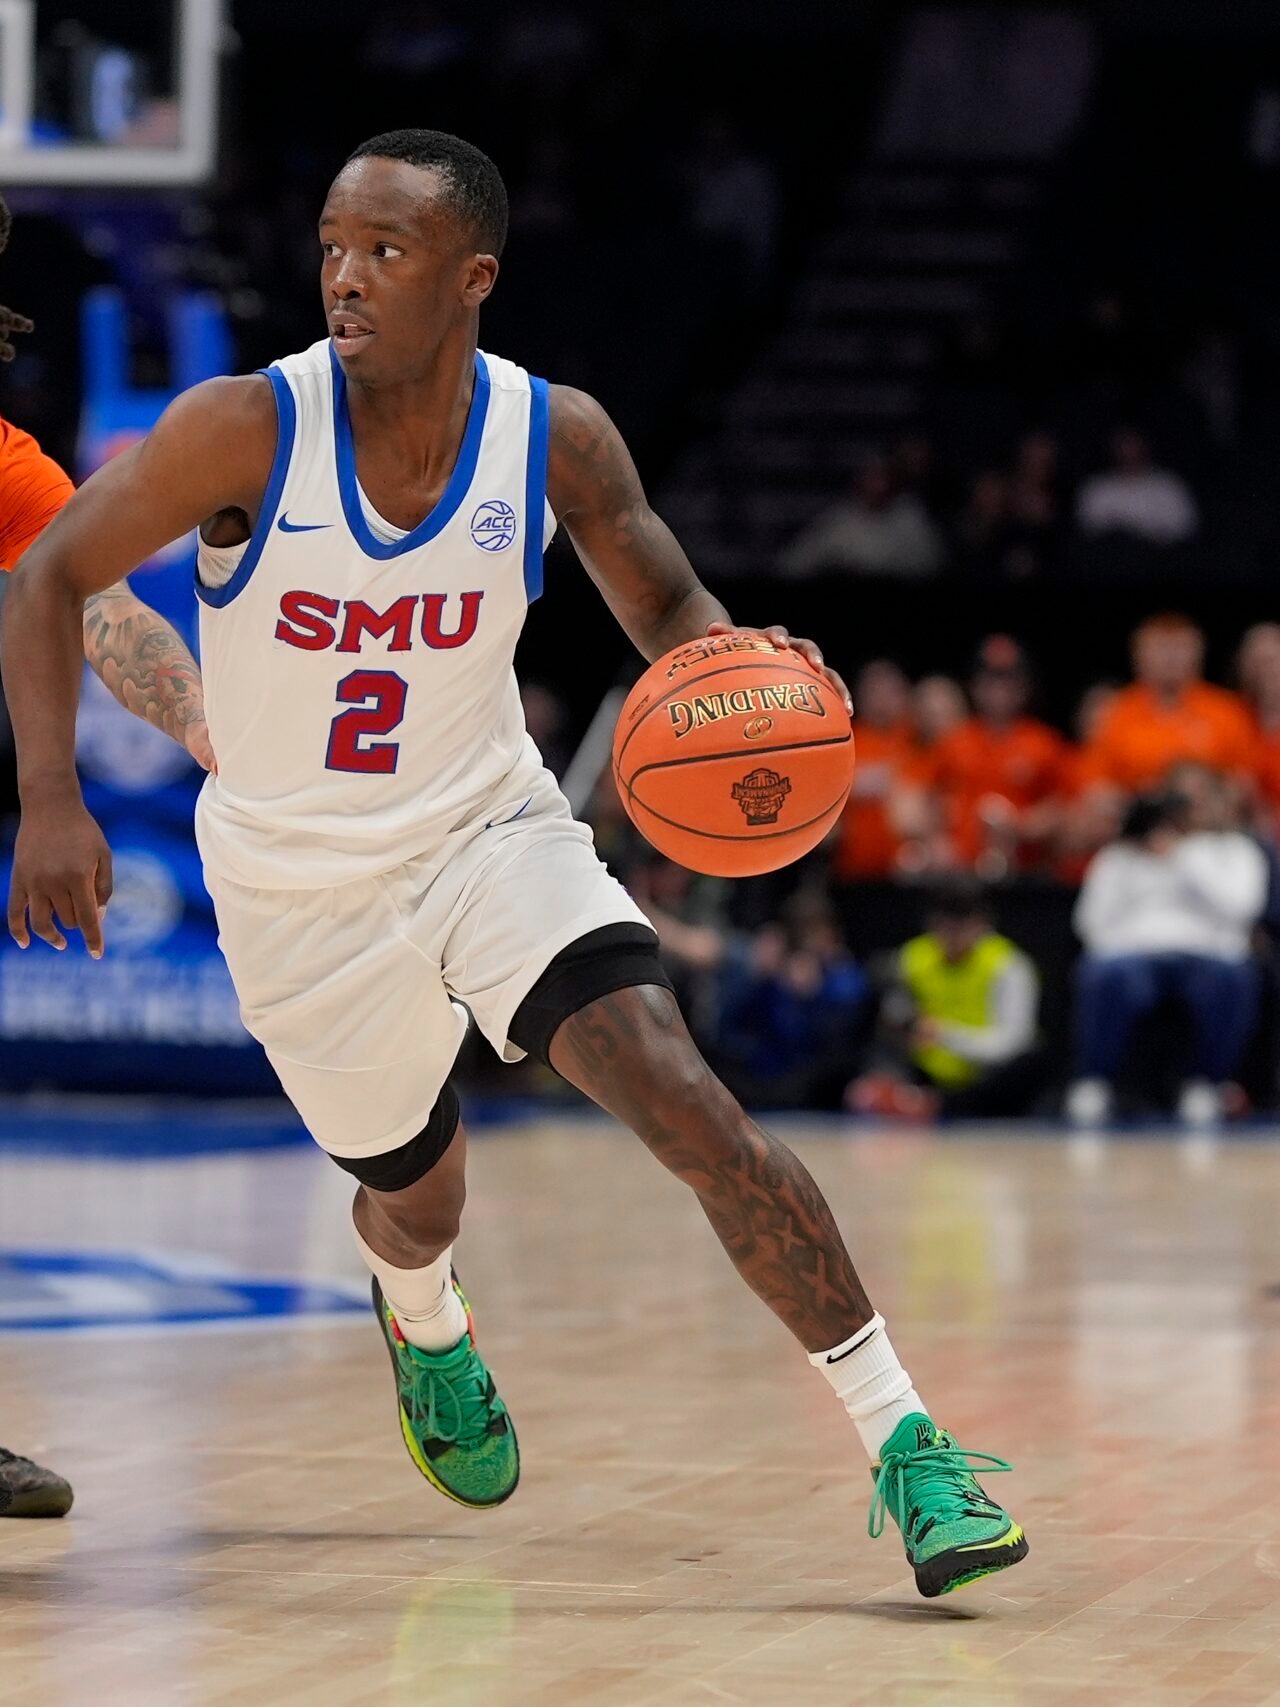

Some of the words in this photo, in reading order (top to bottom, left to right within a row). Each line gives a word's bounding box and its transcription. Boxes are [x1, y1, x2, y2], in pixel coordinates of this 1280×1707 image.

[477, 515, 515, 529] ACC
[274, 590, 484, 653] SMU
[325, 669, 408, 774] 2
[668, 683, 826, 739] SPALDING
